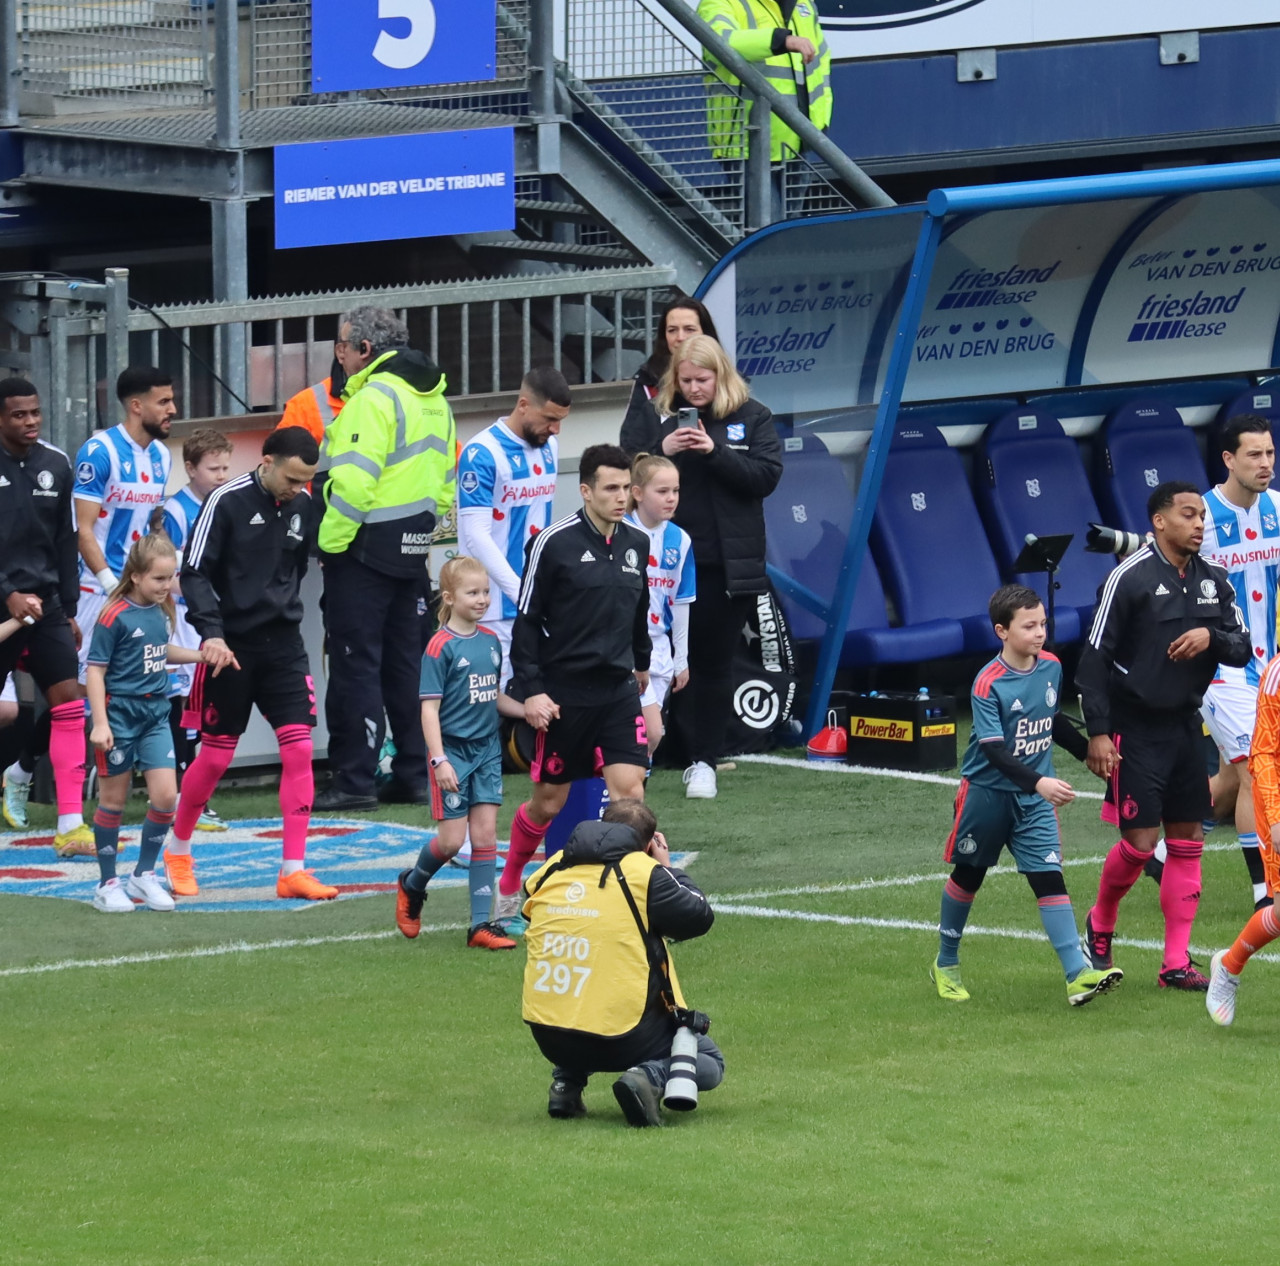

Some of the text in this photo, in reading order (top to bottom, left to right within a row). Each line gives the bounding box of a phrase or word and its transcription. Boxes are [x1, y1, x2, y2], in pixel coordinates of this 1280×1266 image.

[372, 0, 436, 69] 5
[284, 172, 506, 203] RIEMER VAN DER VELDE TRIBUNE
[1128, 250, 1176, 270] Beter
[948, 261, 1063, 291] friesland
[1147, 265, 1186, 281] VAN
[1189, 261, 1230, 278] DEN
[776, 298, 817, 314] DEN
[821, 293, 873, 310] BRUG
[985, 289, 1038, 307] lease
[1137, 287, 1247, 320] friesland
[916, 325, 940, 340] ter
[1176, 320, 1227, 339] lease
[916, 333, 1055, 363] VAN DEN BRUG
[764, 356, 815, 375] lease
[756, 591, 782, 673] DERBYSTAR
[143, 643, 167, 660] Eur
[143, 658, 167, 675] Par
[469, 674, 496, 689] Euro
[469, 689, 497, 705] Parc
[781, 682, 796, 721] divisie
[634, 715, 648, 745] 2
[854, 718, 907, 740] PowerBar
[1014, 716, 1052, 738] Euro
[544, 904, 600, 918] eredivisie
[542, 933, 591, 961] FOTO
[532, 960, 593, 998] 297
